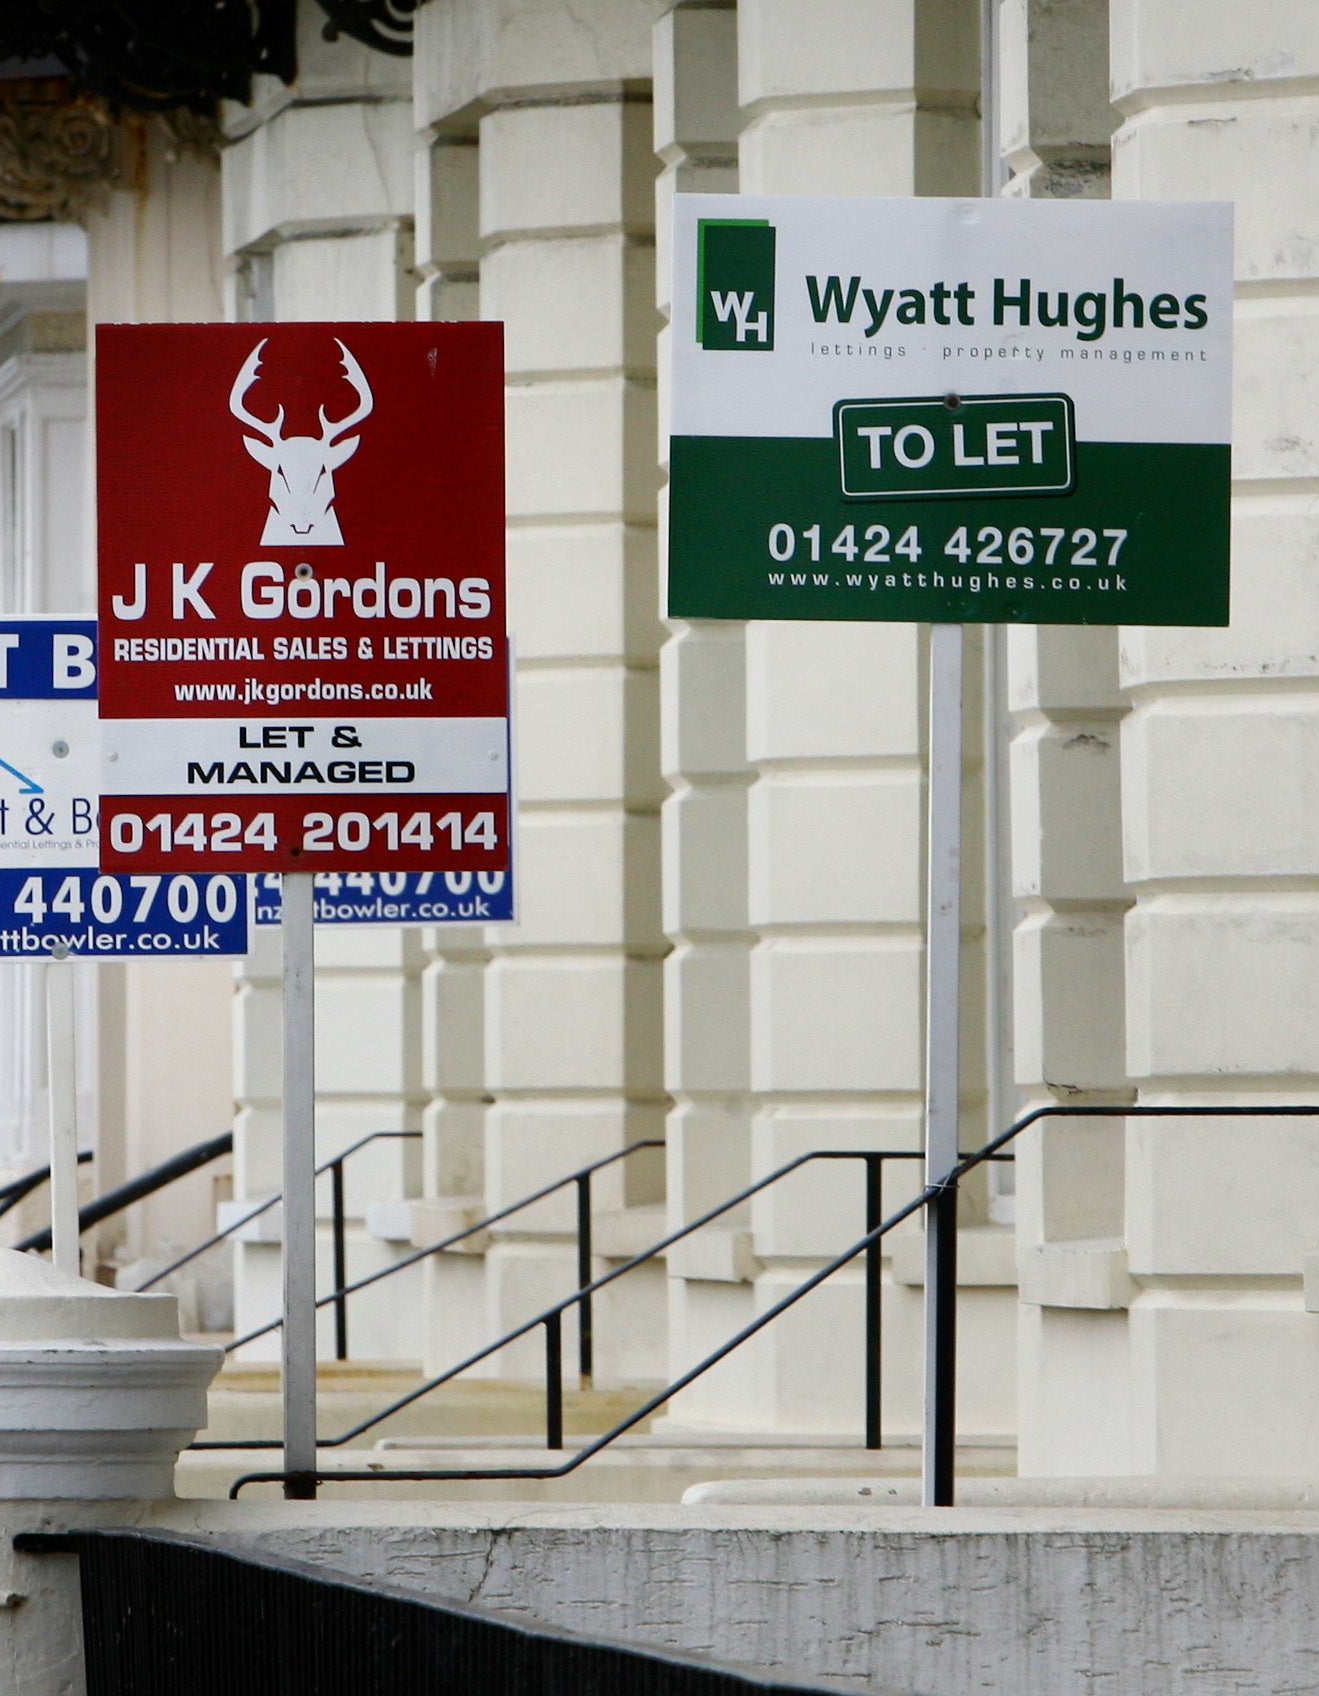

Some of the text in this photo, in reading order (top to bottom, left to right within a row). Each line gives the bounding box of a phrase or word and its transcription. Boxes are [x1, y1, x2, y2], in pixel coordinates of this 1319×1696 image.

[711, 290, 768, 343] WH
[805, 275, 1208, 341] Wyatt Hughes
[811, 341, 1207, 364] lettings property management
[857, 421, 1054, 470] TO LET
[767, 522, 1128, 567] 01424 426727
[111, 561, 492, 620] J K Gordons
[767, 571, 1128, 593] www.wyatthughes.co.uk
[113, 636, 494, 662] RESIDENTIAL SALES & LETTINGS
[174, 678, 434, 705] www.jkgordons.co.uk
[238, 725, 363, 750] LET &
[186, 760, 416, 785] MANAGED
[25, 797, 56, 836] &
[110, 810, 499, 854] 01424 201414
[12, 873, 238, 926] 440700
